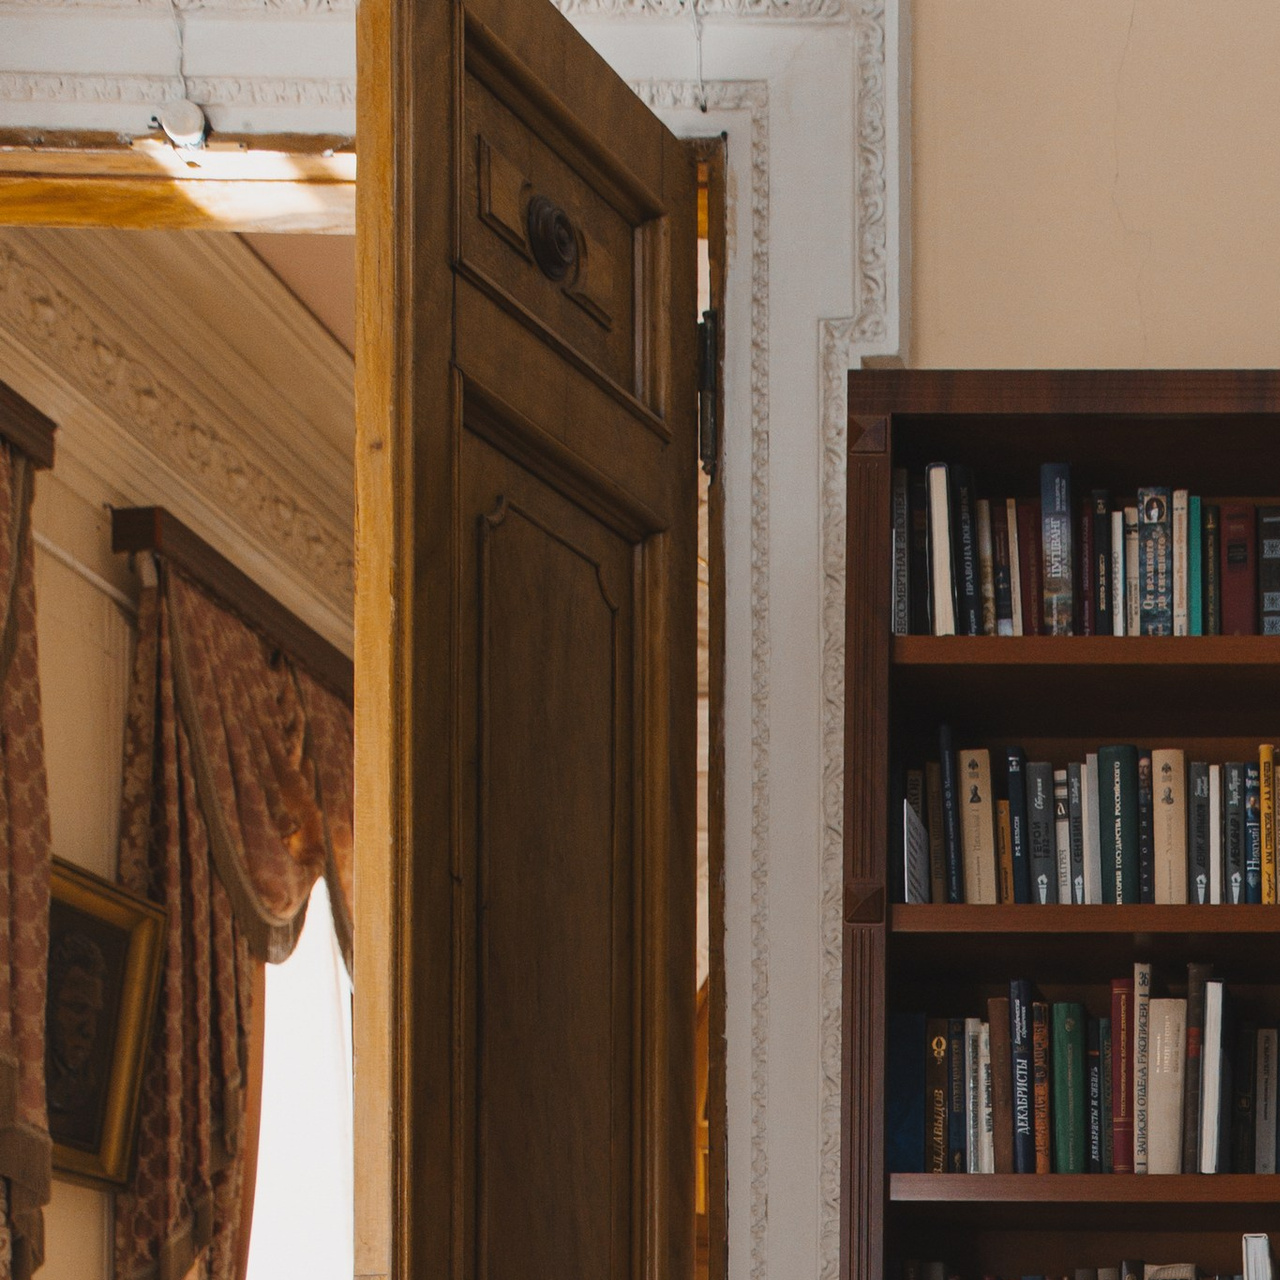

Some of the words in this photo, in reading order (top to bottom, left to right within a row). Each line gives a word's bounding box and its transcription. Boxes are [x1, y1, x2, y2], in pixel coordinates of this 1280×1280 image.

[896, 547, 907, 633] БЕССМЕРТНАЯ
[965, 562, 974, 595] ПРАВО
[1143, 593, 1154, 610] От
[1073, 816, 1082, 864] СЕНЯВИН
[1136, 1003, 1148, 1064] РУКОПИСЕЙ
[1015, 1057, 1030, 1135] ДЕКАБРИСТЫ
[1090, 1066, 1099, 1098] СИБИРЬ
[1136, 1067, 1147, 1107] ОТДЕЛА
[1090, 1108, 1100, 1162] ДЕКАБРИСТЫ
[1136, 1109, 1147, 1156] ЗАПИСКИ
